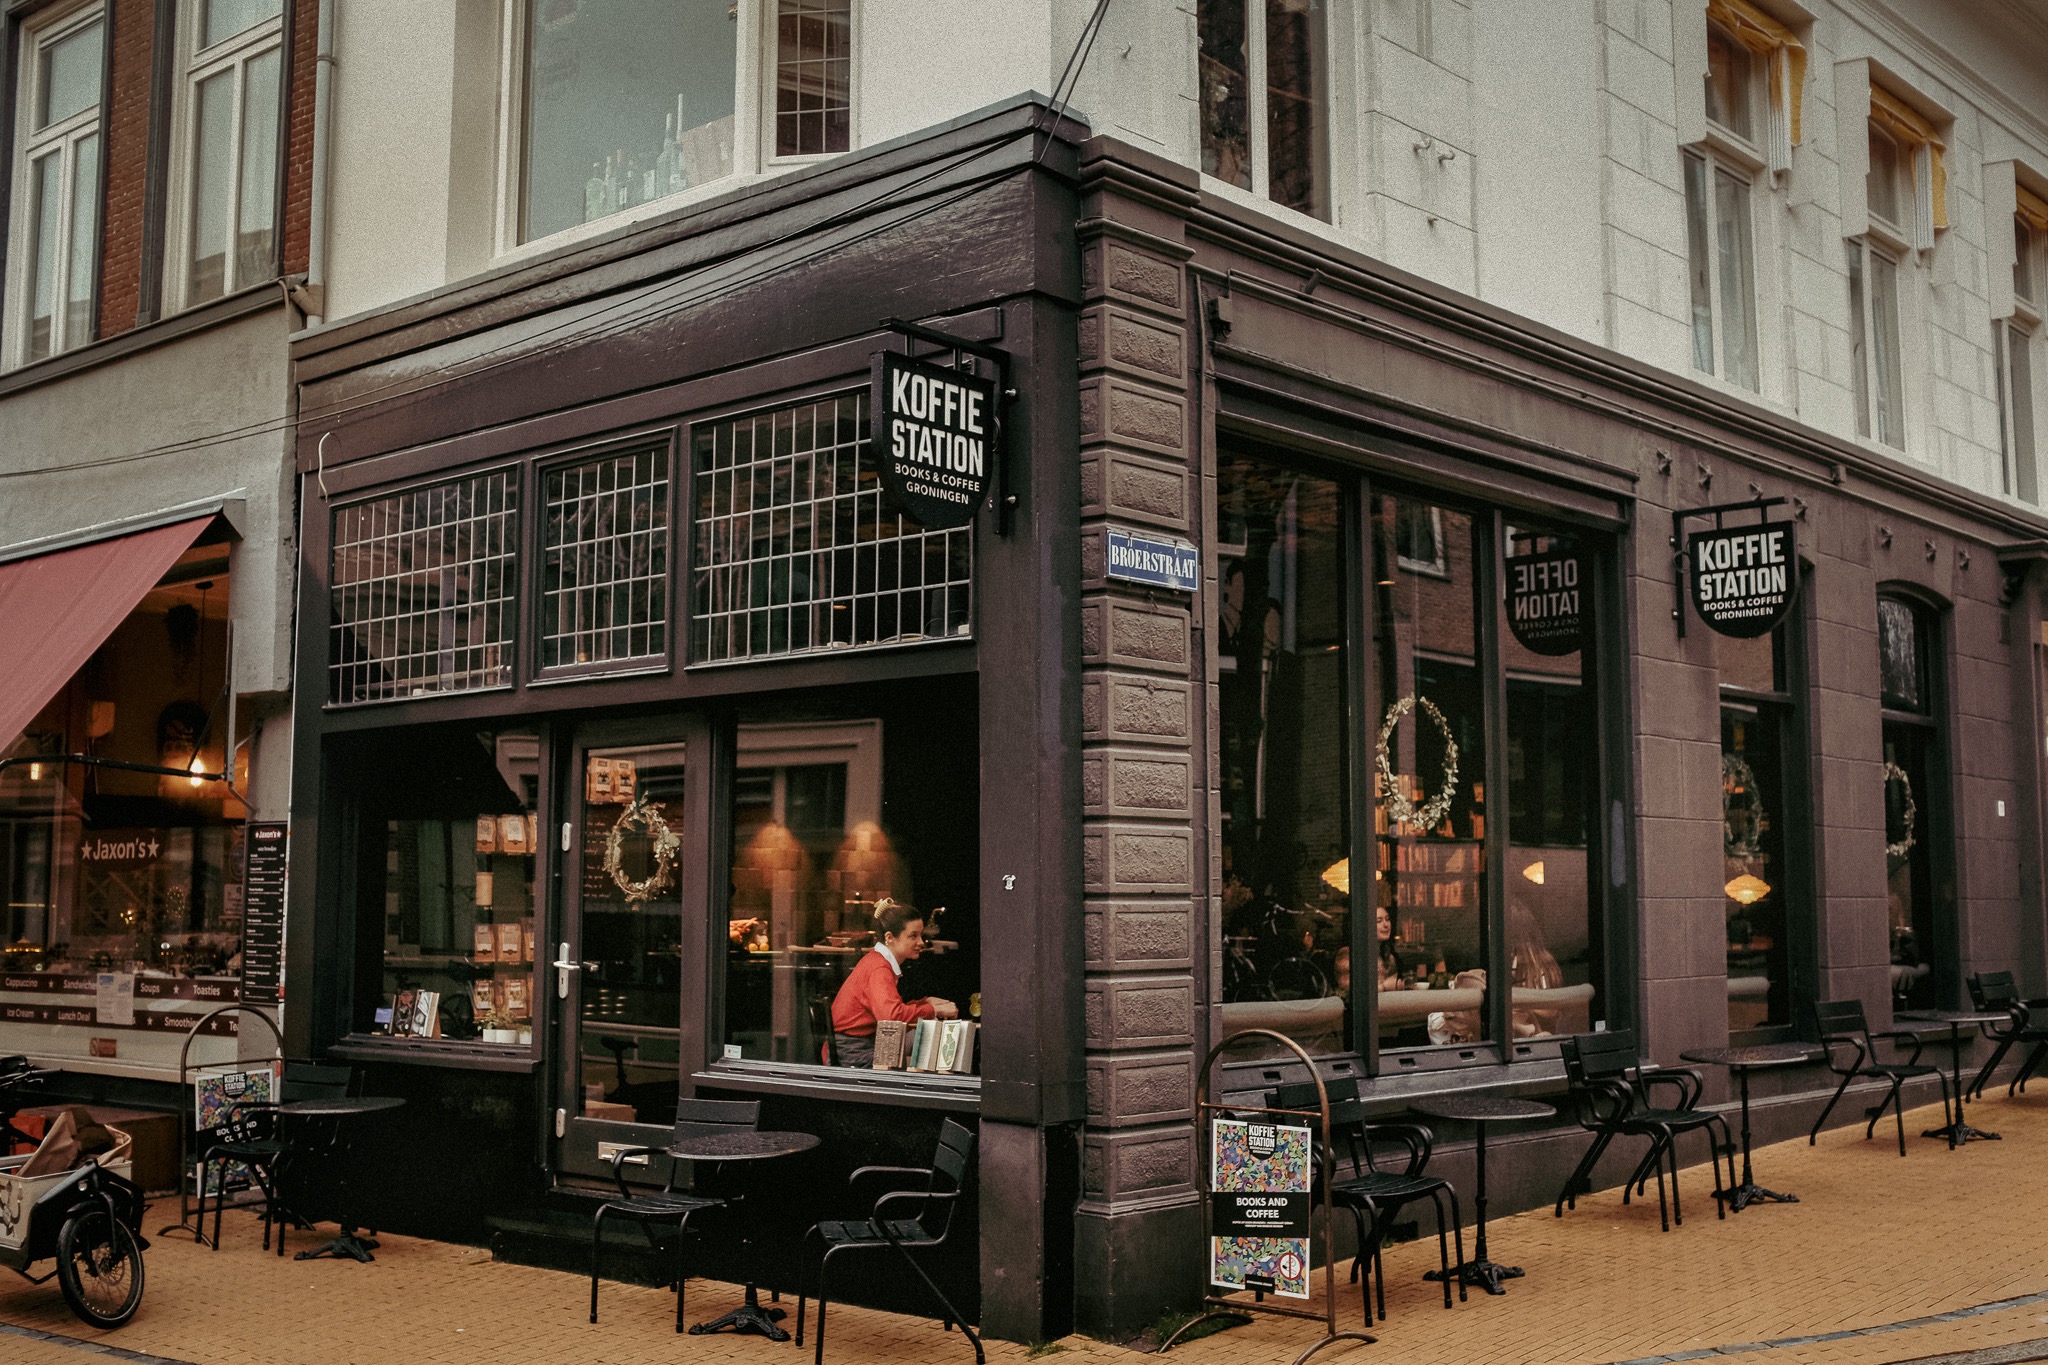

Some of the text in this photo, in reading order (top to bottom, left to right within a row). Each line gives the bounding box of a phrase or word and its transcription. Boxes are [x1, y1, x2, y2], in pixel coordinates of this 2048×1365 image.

[892, 368, 984, 435] KOFFIE
[892, 418, 984, 477] STATION
[895, 463, 980, 492] BOOKS & COFFEE
[906, 481, 969, 505] GRONINGEN
[1698, 531, 1785, 572] KOFFIE
[1111, 544, 1196, 579] BROERSTRAAT
[1700, 565, 1787, 601] STATION
[1703, 595, 1784, 612] BOOKS & COFFEE
[1714, 607, 1774, 620] GRONINGEN
[92, 838, 146, 861] Jaxon's
[5, 977, 38, 988] Cappuccino
[63, 979, 97, 990] Sandwiche
[140, 982, 160, 995] Soups
[193, 984, 221, 996] Toasties
[6, 1008, 35, 1018] Ice Cream
[58, 1010, 91, 1022] Lunch Deal
[164, 1016, 200, 1028] Smoothie
[224, 1073, 246, 1083] KOFFIE
[224, 1081, 246, 1091] STATION
[1248, 1125, 1275, 1138] KOFFIE
[1248, 1136, 1275, 1148] STATION
[1236, 1197, 1288, 1207] BOOKS AND
[1245, 1209, 1280, 1219] COFFEE
